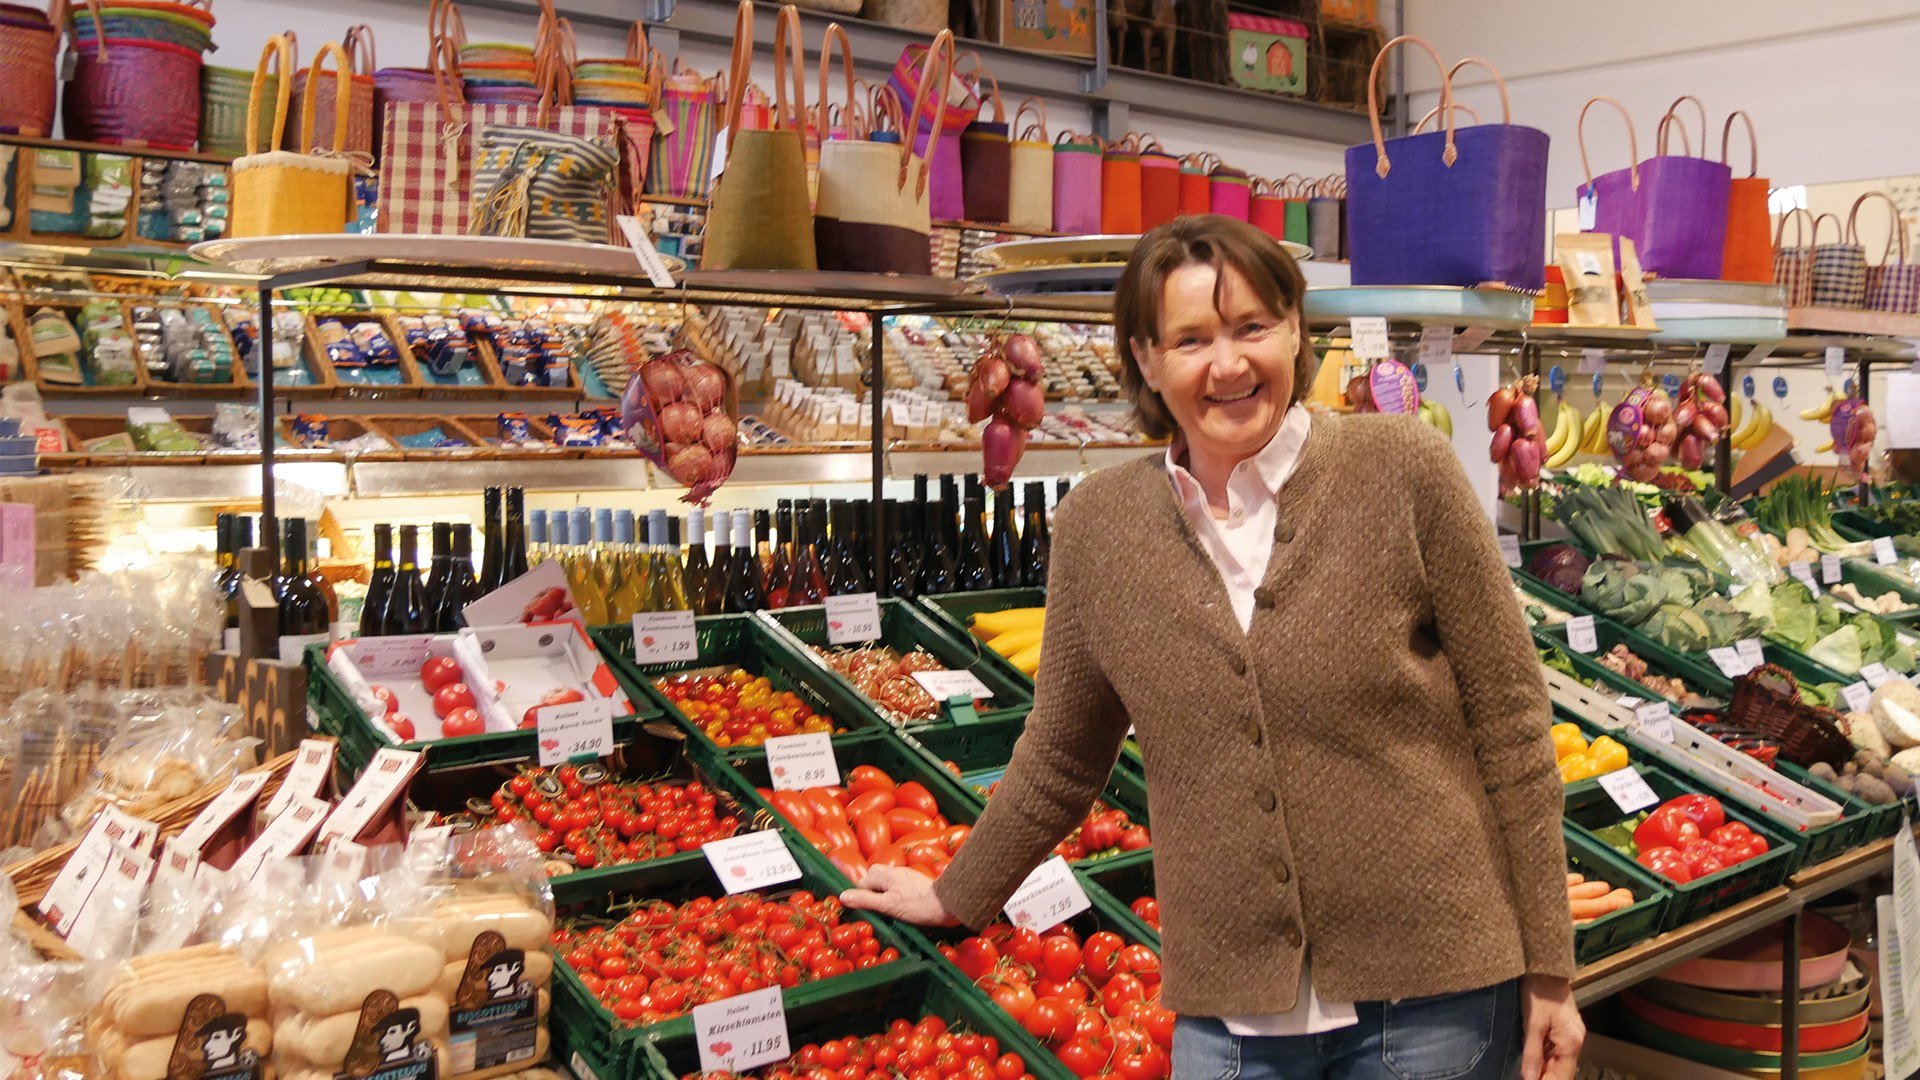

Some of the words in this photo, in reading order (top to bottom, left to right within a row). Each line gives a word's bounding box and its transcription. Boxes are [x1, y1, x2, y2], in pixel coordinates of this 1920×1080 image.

[726, 1003, 750, 1016] Italien
[708, 1009, 782, 1038] Kirschtomaten
[751, 1033, 782, 1057] 11.95
